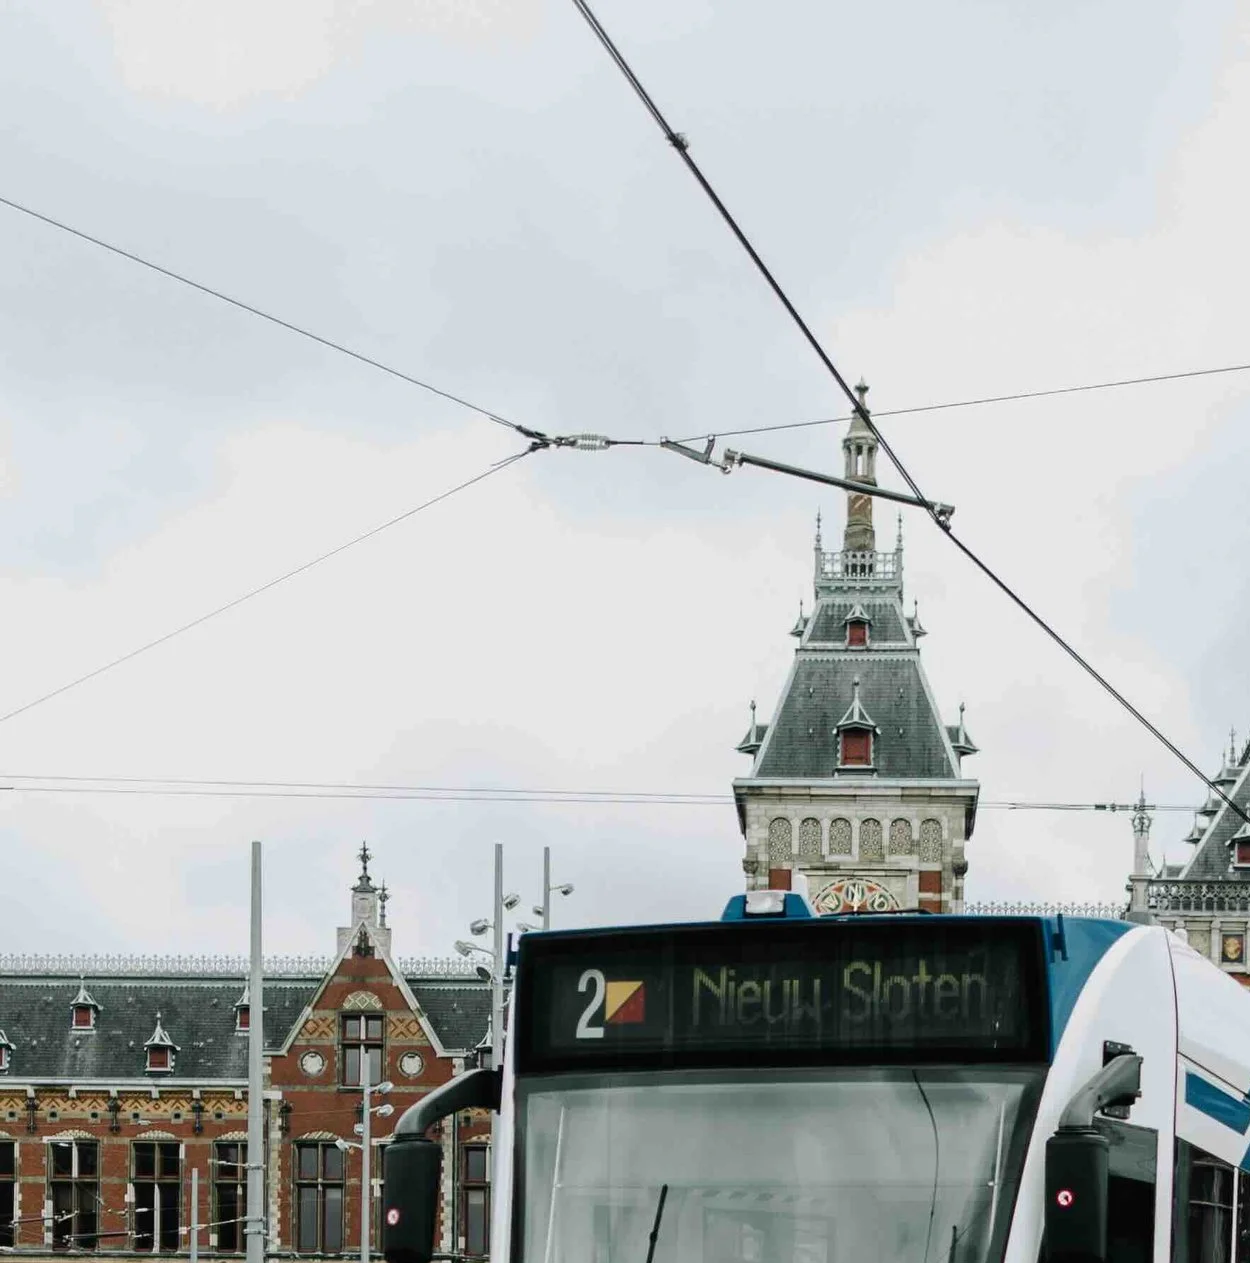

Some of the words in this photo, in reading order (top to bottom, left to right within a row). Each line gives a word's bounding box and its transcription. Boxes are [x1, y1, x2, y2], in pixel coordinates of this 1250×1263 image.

[576, 968, 606, 1039] 2
[693, 965, 821, 1028] Nieuw
[843, 959, 990, 1022] Sloten
